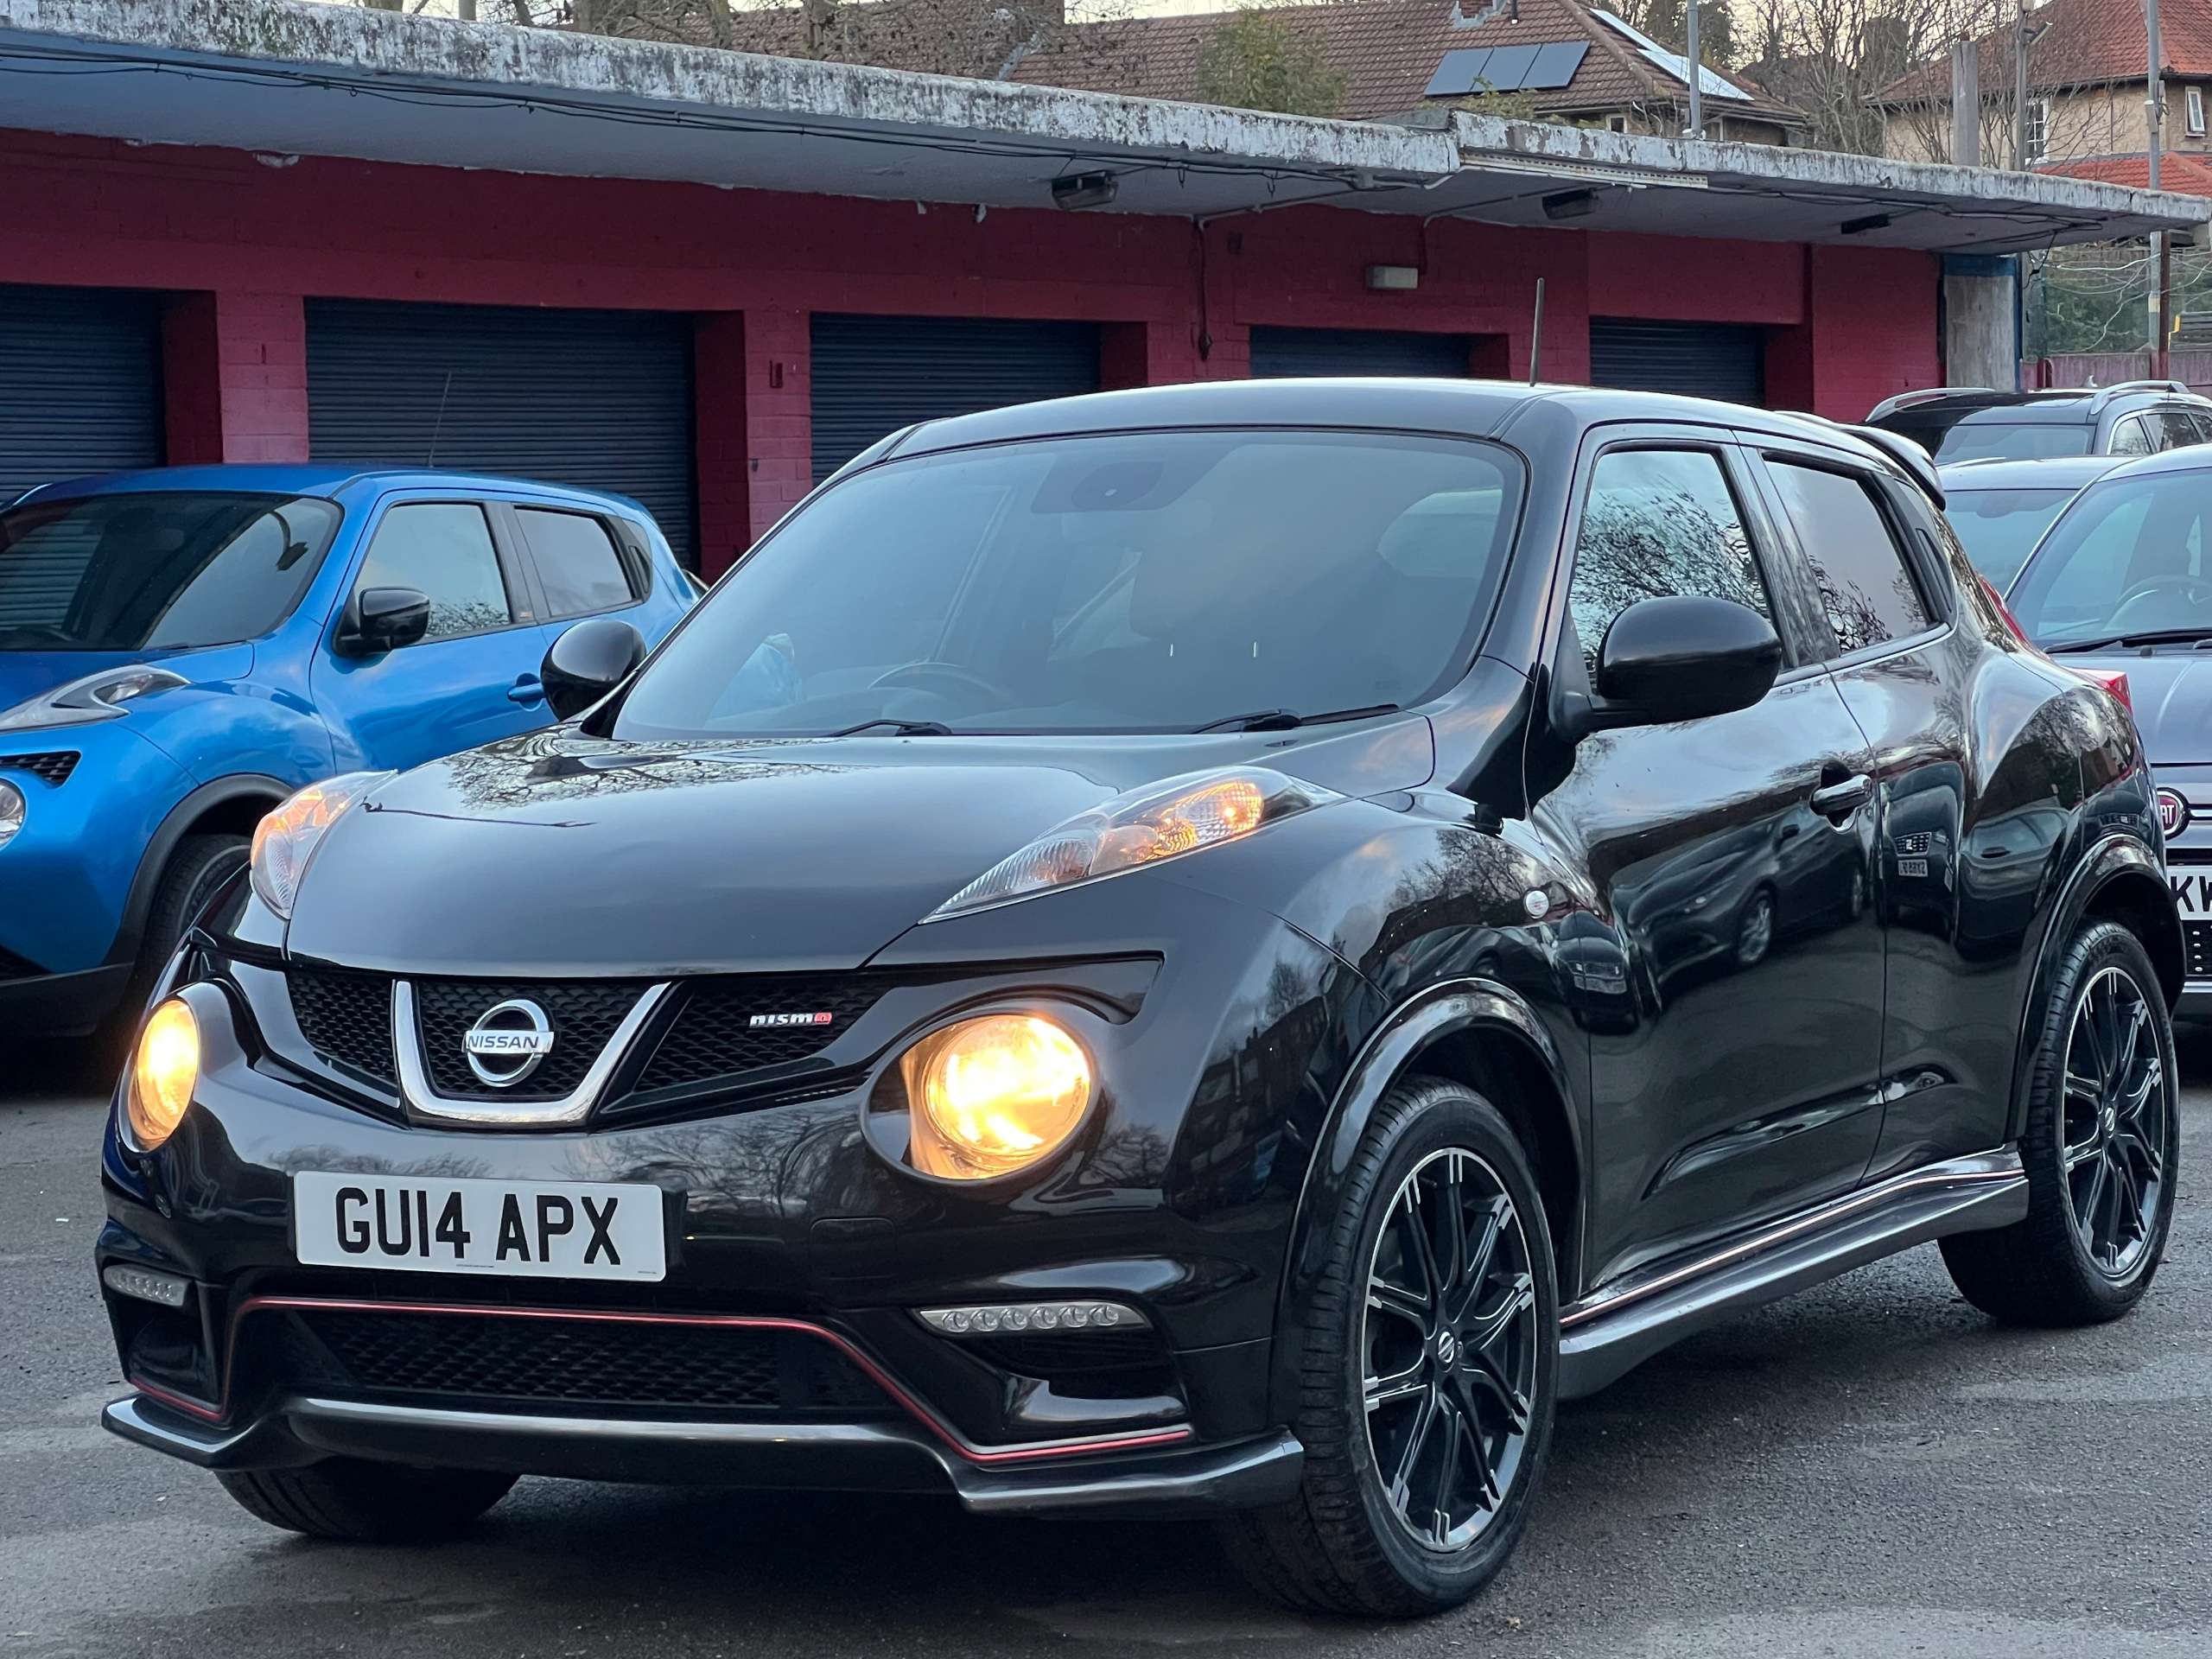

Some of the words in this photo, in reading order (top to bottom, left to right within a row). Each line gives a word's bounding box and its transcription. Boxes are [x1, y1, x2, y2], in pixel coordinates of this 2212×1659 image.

[2159, 804, 2175, 824] AT
[467, 1035, 539, 1049] NISSAN
[335, 1186, 471, 1259] GU14
[495, 1192, 621, 1266] APX
